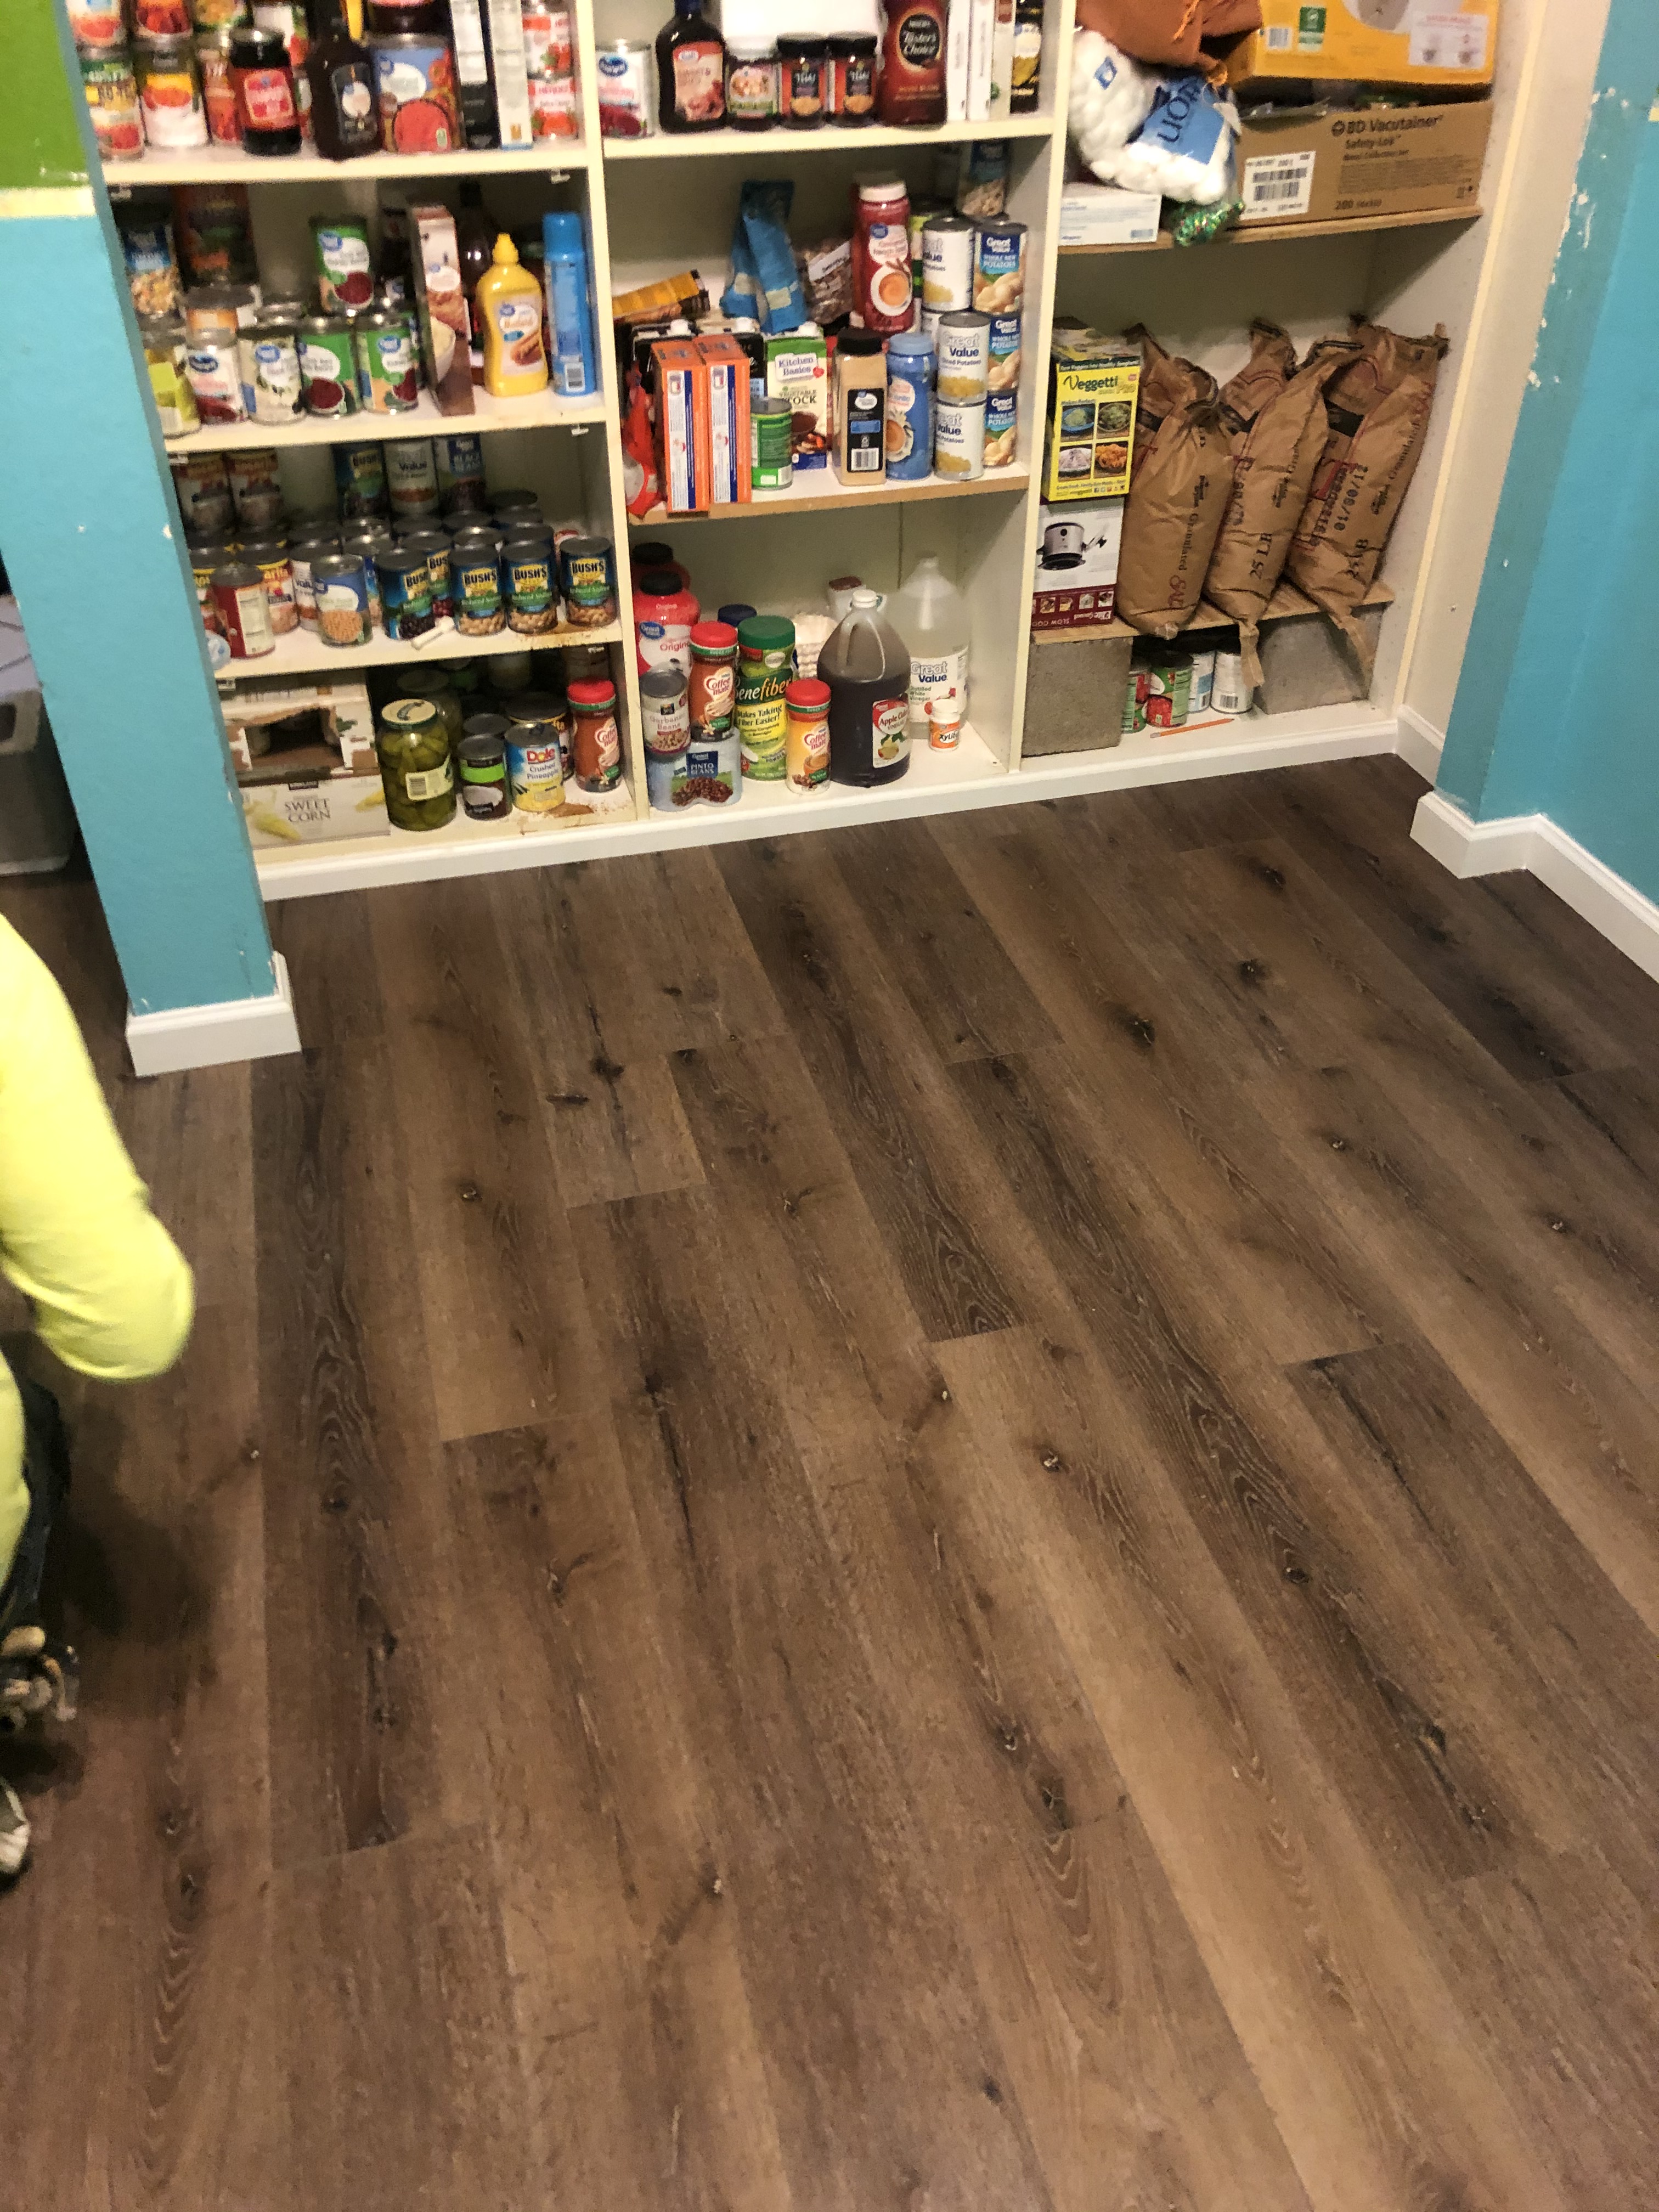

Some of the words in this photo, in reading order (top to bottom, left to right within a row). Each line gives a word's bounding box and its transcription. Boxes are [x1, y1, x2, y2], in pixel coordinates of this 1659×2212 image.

[950, 347, 980, 357] Value
[778, 357, 814, 368] Kitchen
[783, 366, 811, 376] Basics
[1063, 375, 1119, 392] Veggetti
[1178, 513, 1199, 571] Granulated
[514, 566, 547, 580] BUSH'S
[572, 560, 605, 574] BUSH'S
[660, 641, 691, 652] Origin
[911, 661, 948, 675] Great
[918, 674, 947, 683] Value
[879, 715, 898, 727] Apple
[527, 747, 555, 763] Dole
[529, 763, 556, 772] Crushed
[527, 769, 559, 780] Pineapple
[284, 798, 330, 811] SWEET
[287, 810, 331, 822] CORN
